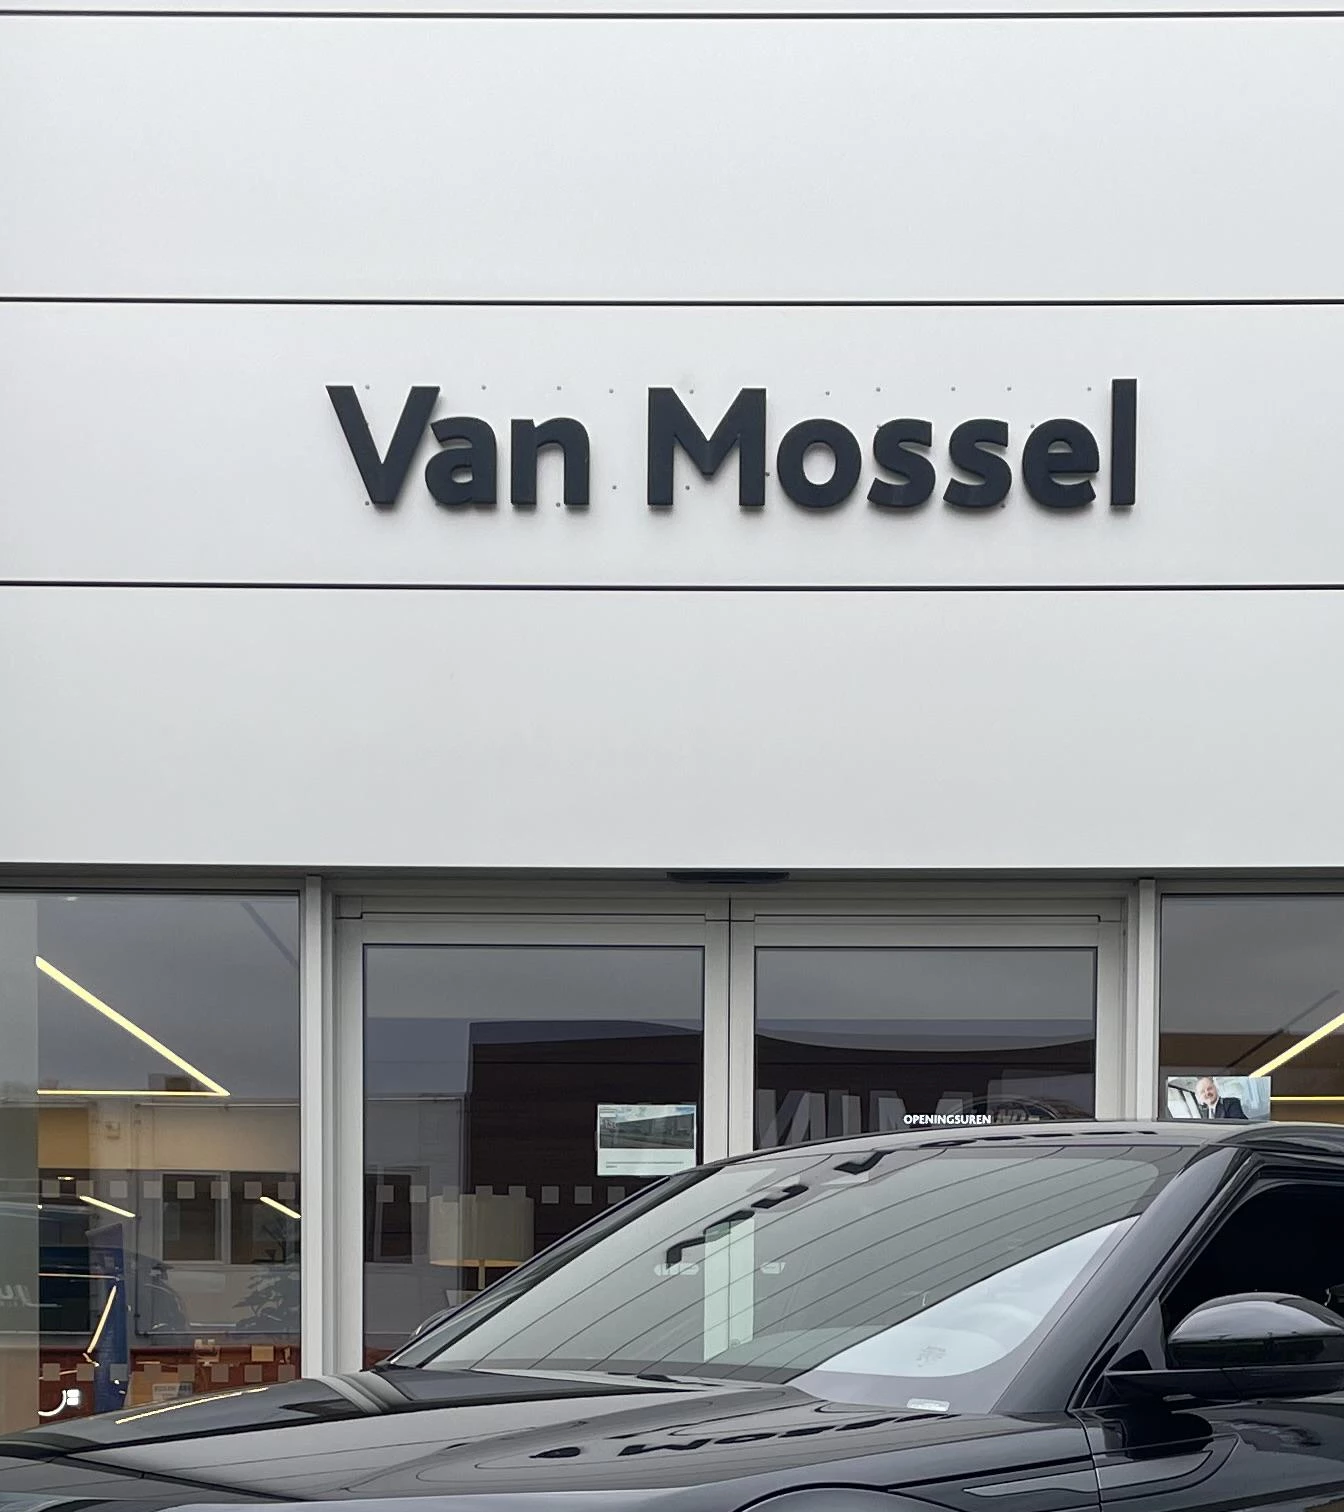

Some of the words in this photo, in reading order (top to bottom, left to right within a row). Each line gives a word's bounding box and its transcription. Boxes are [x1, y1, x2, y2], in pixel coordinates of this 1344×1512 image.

[326, 385, 590, 514] Van
[648, 378, 1137, 516] Mossel
[903, 1114, 992, 1126] OPENINGSUREN
